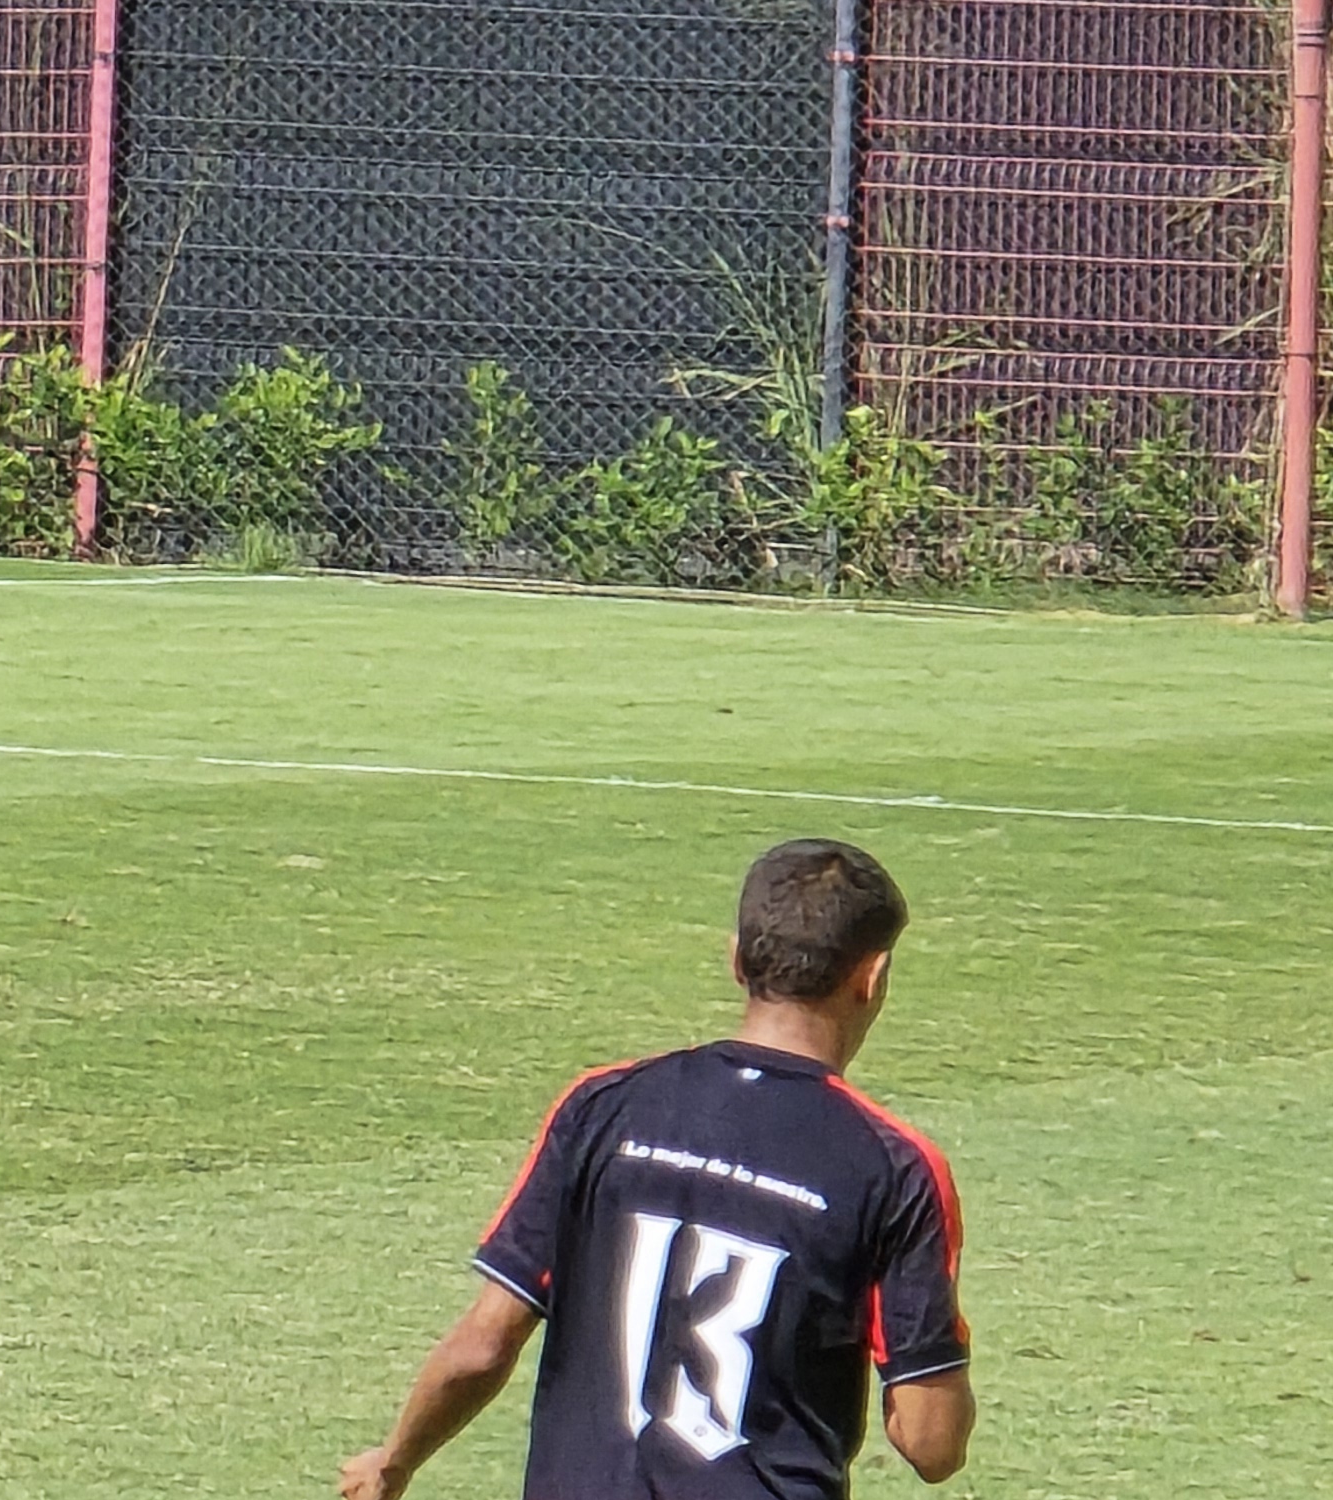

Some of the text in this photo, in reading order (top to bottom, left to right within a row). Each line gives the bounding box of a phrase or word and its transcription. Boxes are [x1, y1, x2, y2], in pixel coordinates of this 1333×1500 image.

[623, 1140, 651, 1158] Lo
[652, 1147, 707, 1169] mejor
[706, 1158, 731, 1176] de
[733, 1164, 754, 1183] lo
[626, 1213, 790, 1461] 13
